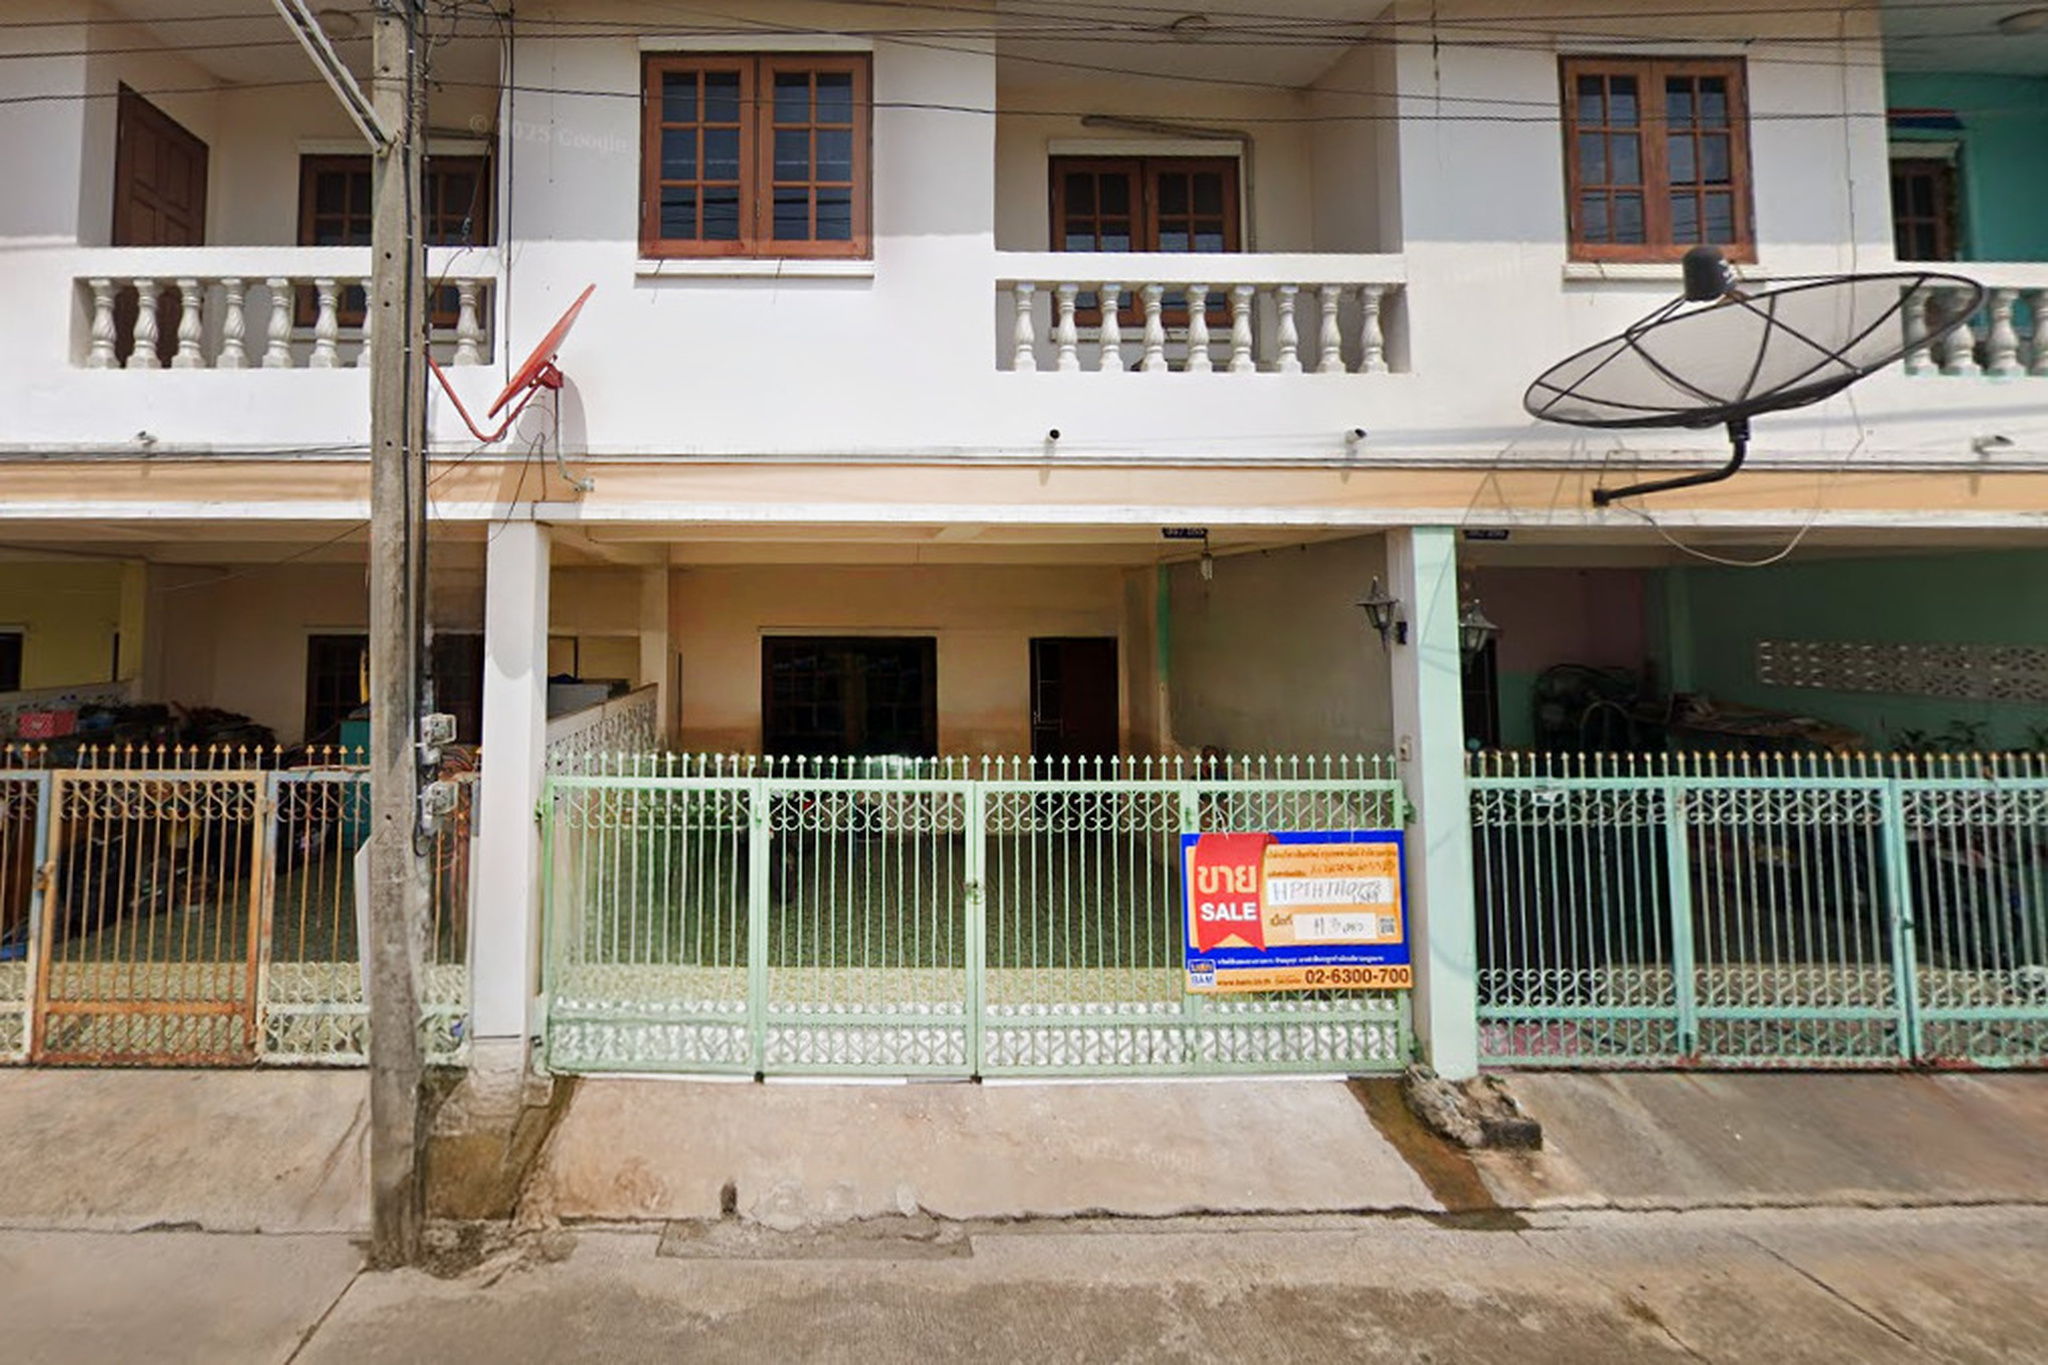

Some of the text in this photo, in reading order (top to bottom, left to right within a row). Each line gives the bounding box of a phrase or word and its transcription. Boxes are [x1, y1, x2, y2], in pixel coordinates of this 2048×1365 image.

[1197, 865, 1257, 894] ขาย
[1201, 902, 1257, 922] SALE
[1305, 968, 1410, 984] 02-6300-700
